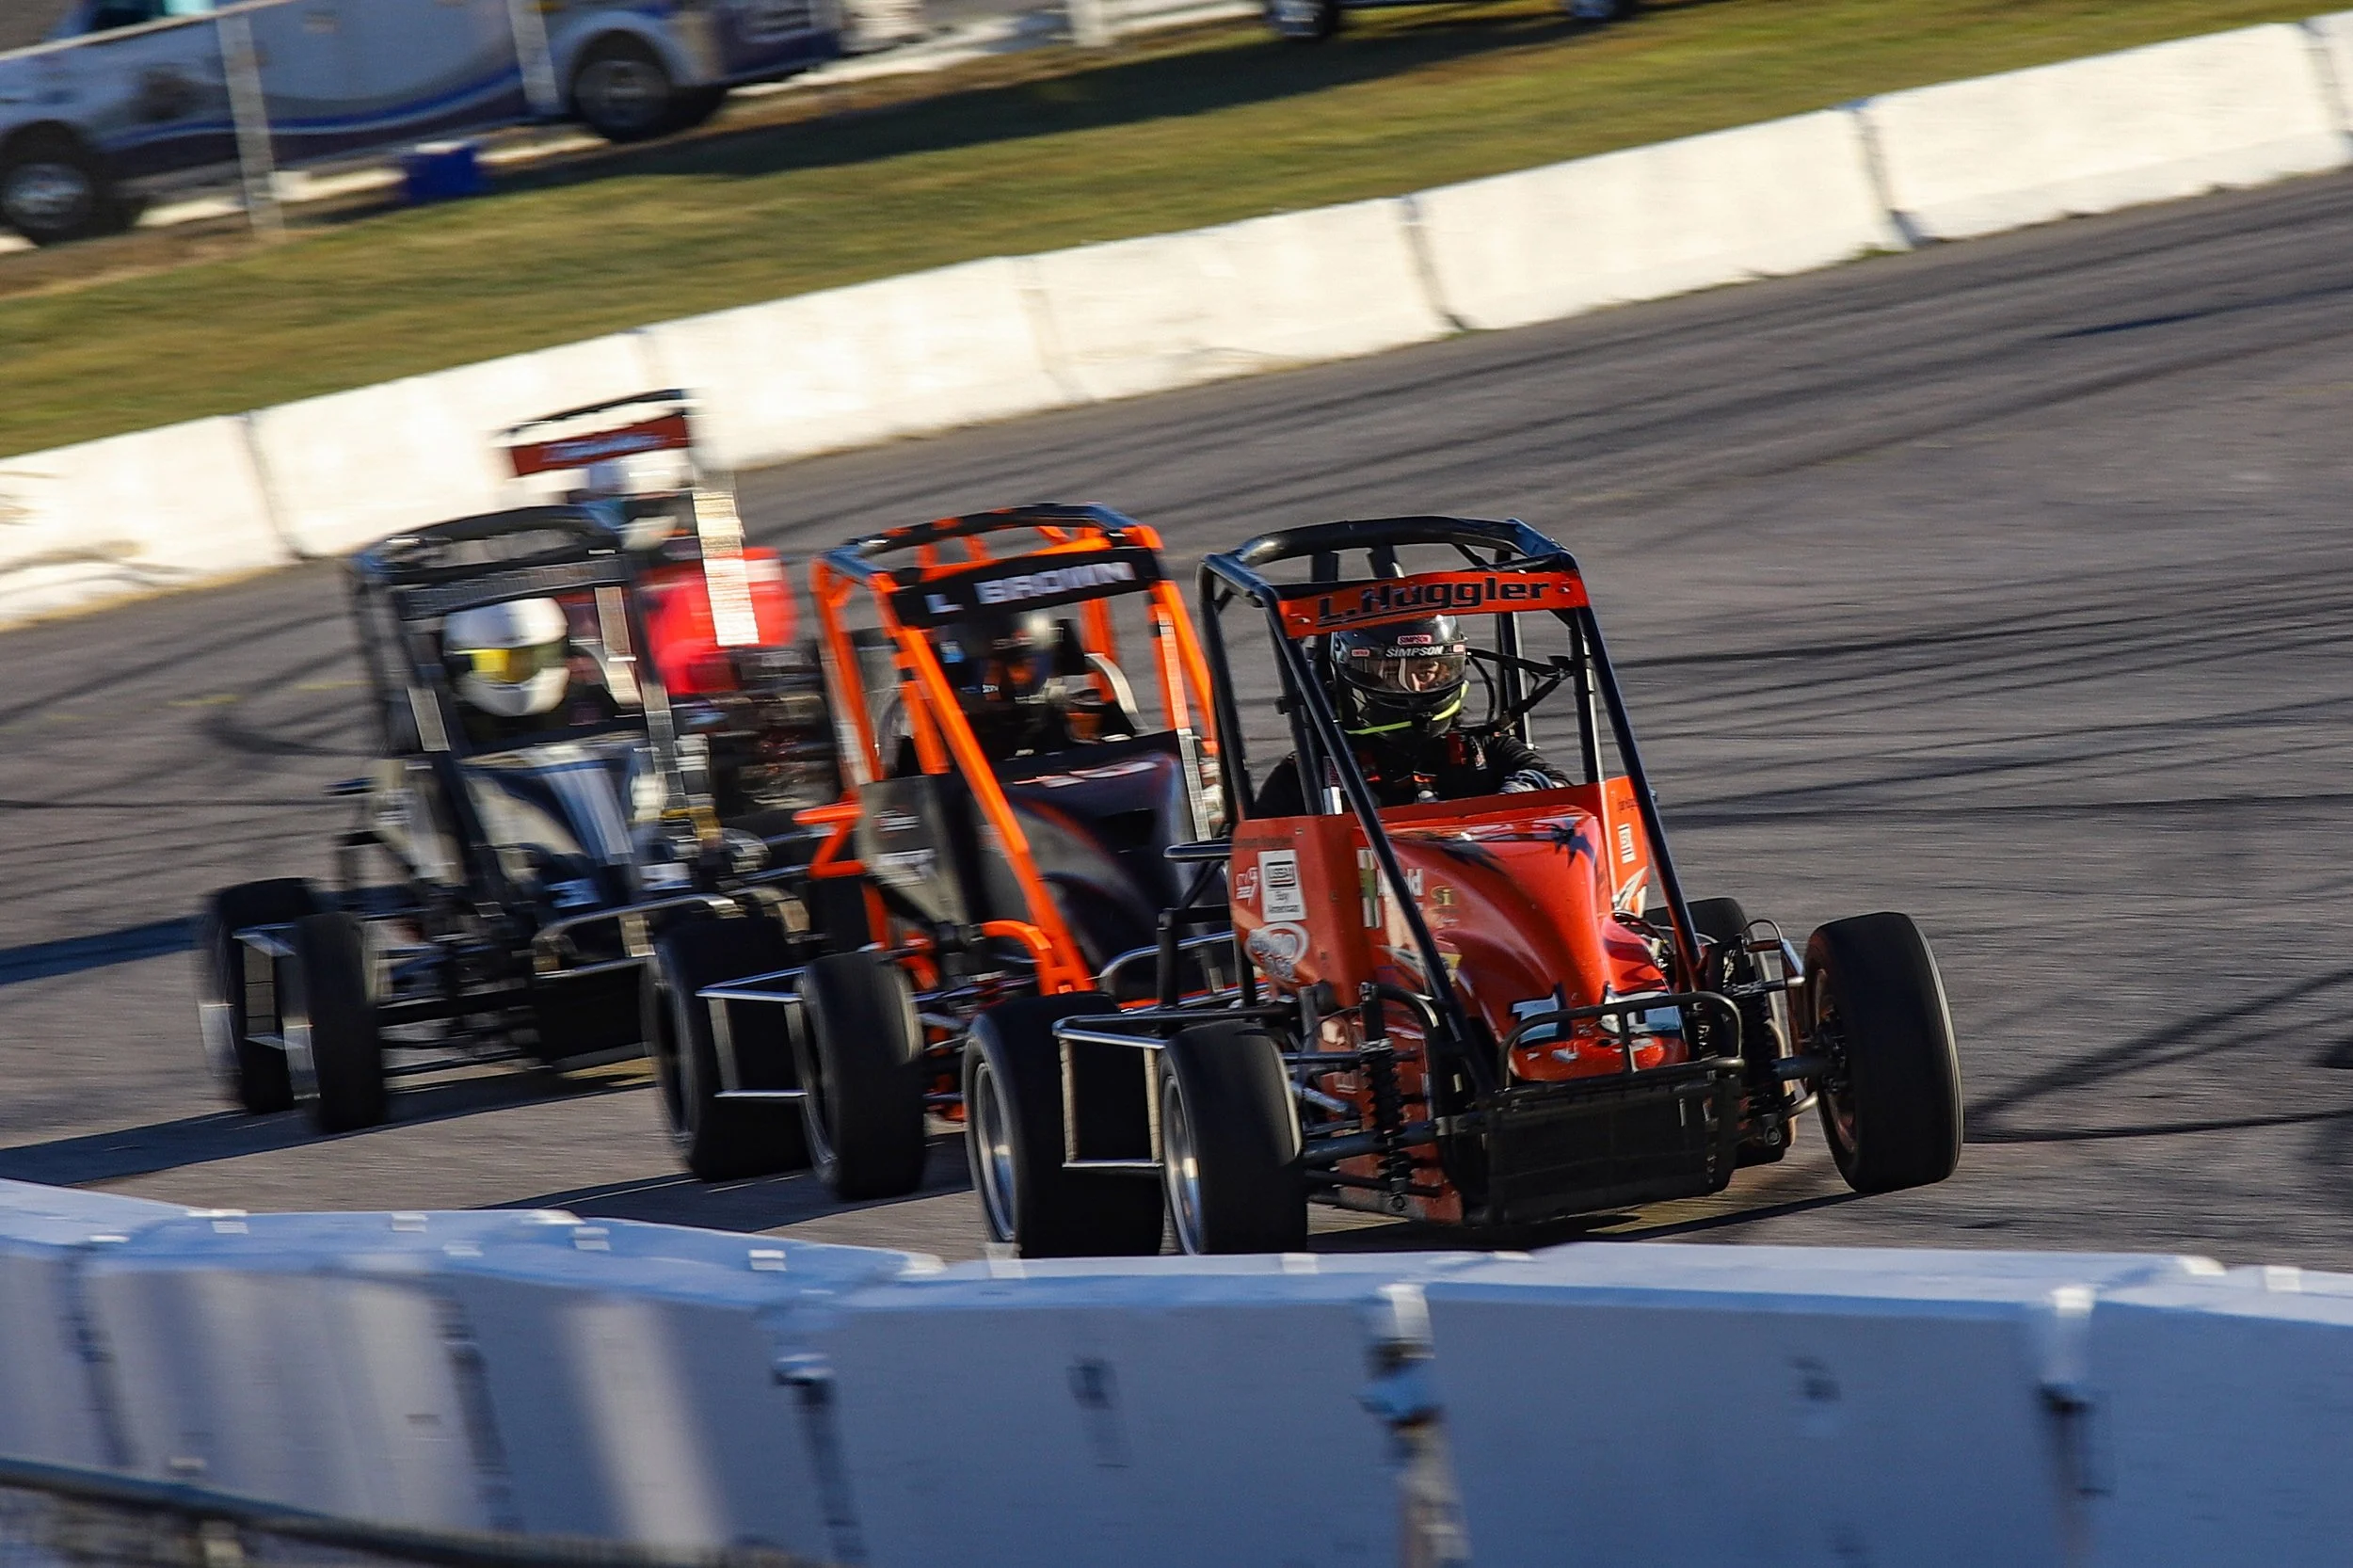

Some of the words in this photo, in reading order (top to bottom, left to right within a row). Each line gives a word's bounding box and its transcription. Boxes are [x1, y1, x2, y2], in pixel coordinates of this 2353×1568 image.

[973, 562, 1136, 604] BROWN
[1319, 577, 1550, 621] L.Huggler
[1385, 645, 1444, 658] SIMPSON
